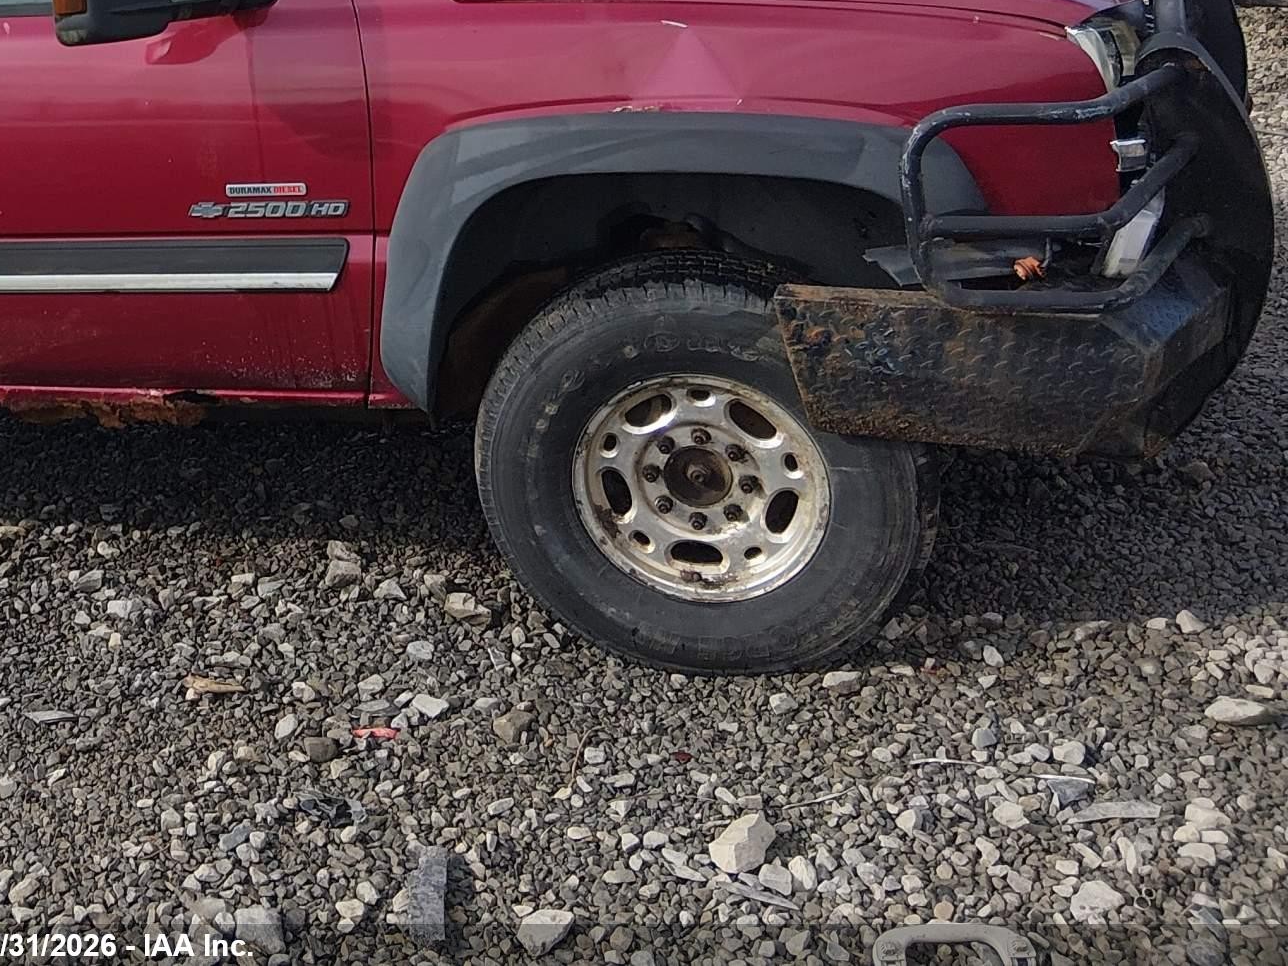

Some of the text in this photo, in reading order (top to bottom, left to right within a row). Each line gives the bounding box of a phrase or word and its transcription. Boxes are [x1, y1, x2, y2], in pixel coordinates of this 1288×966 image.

[229, 185, 303, 195] DURAMAX DIESEL
[227, 201, 346, 218] 2500 HD
